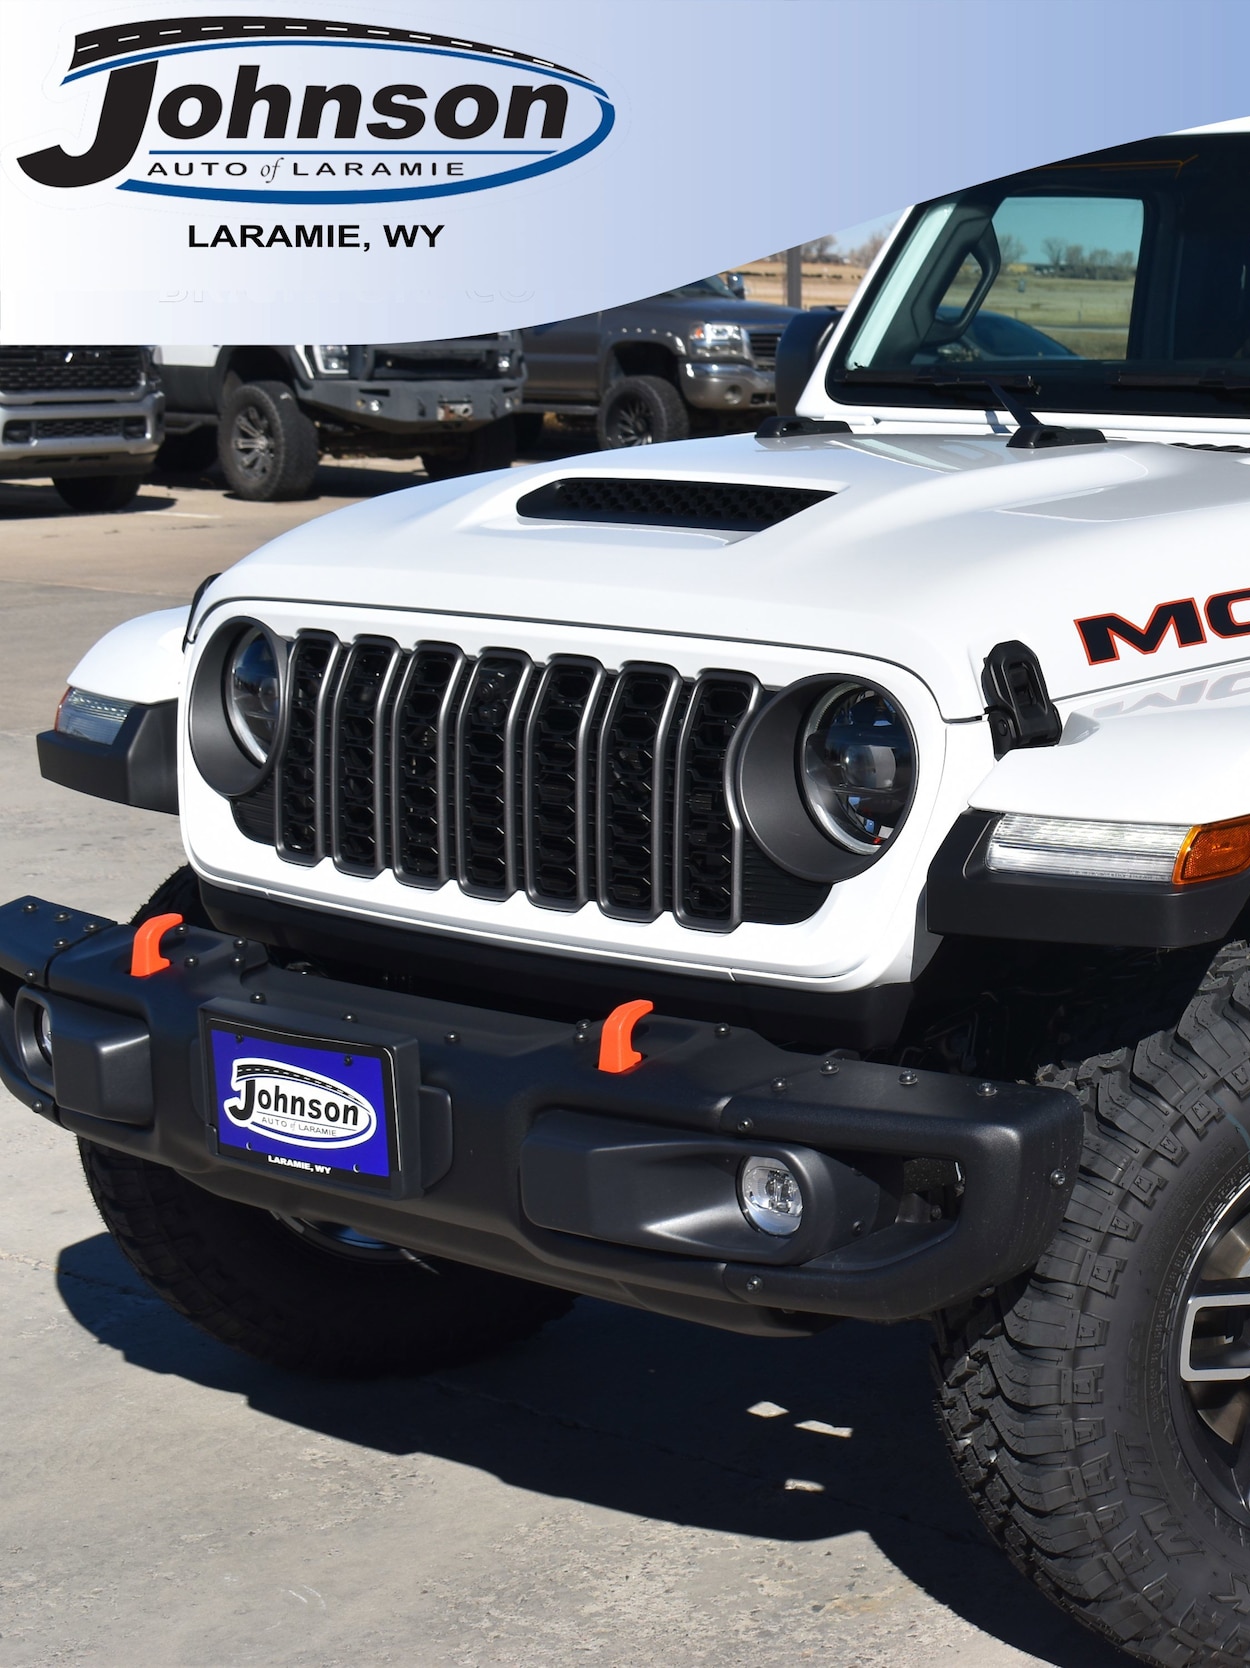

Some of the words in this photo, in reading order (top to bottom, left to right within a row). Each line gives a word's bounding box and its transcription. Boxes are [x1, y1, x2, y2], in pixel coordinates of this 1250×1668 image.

[228, 1079, 359, 1126] Johnson
[261, 1116, 288, 1129] AUTO
[298, 1124, 338, 1137] LARAMIE
[267, 1154, 314, 1173] LARAMIE,
[314, 1163, 332, 1175] WY
